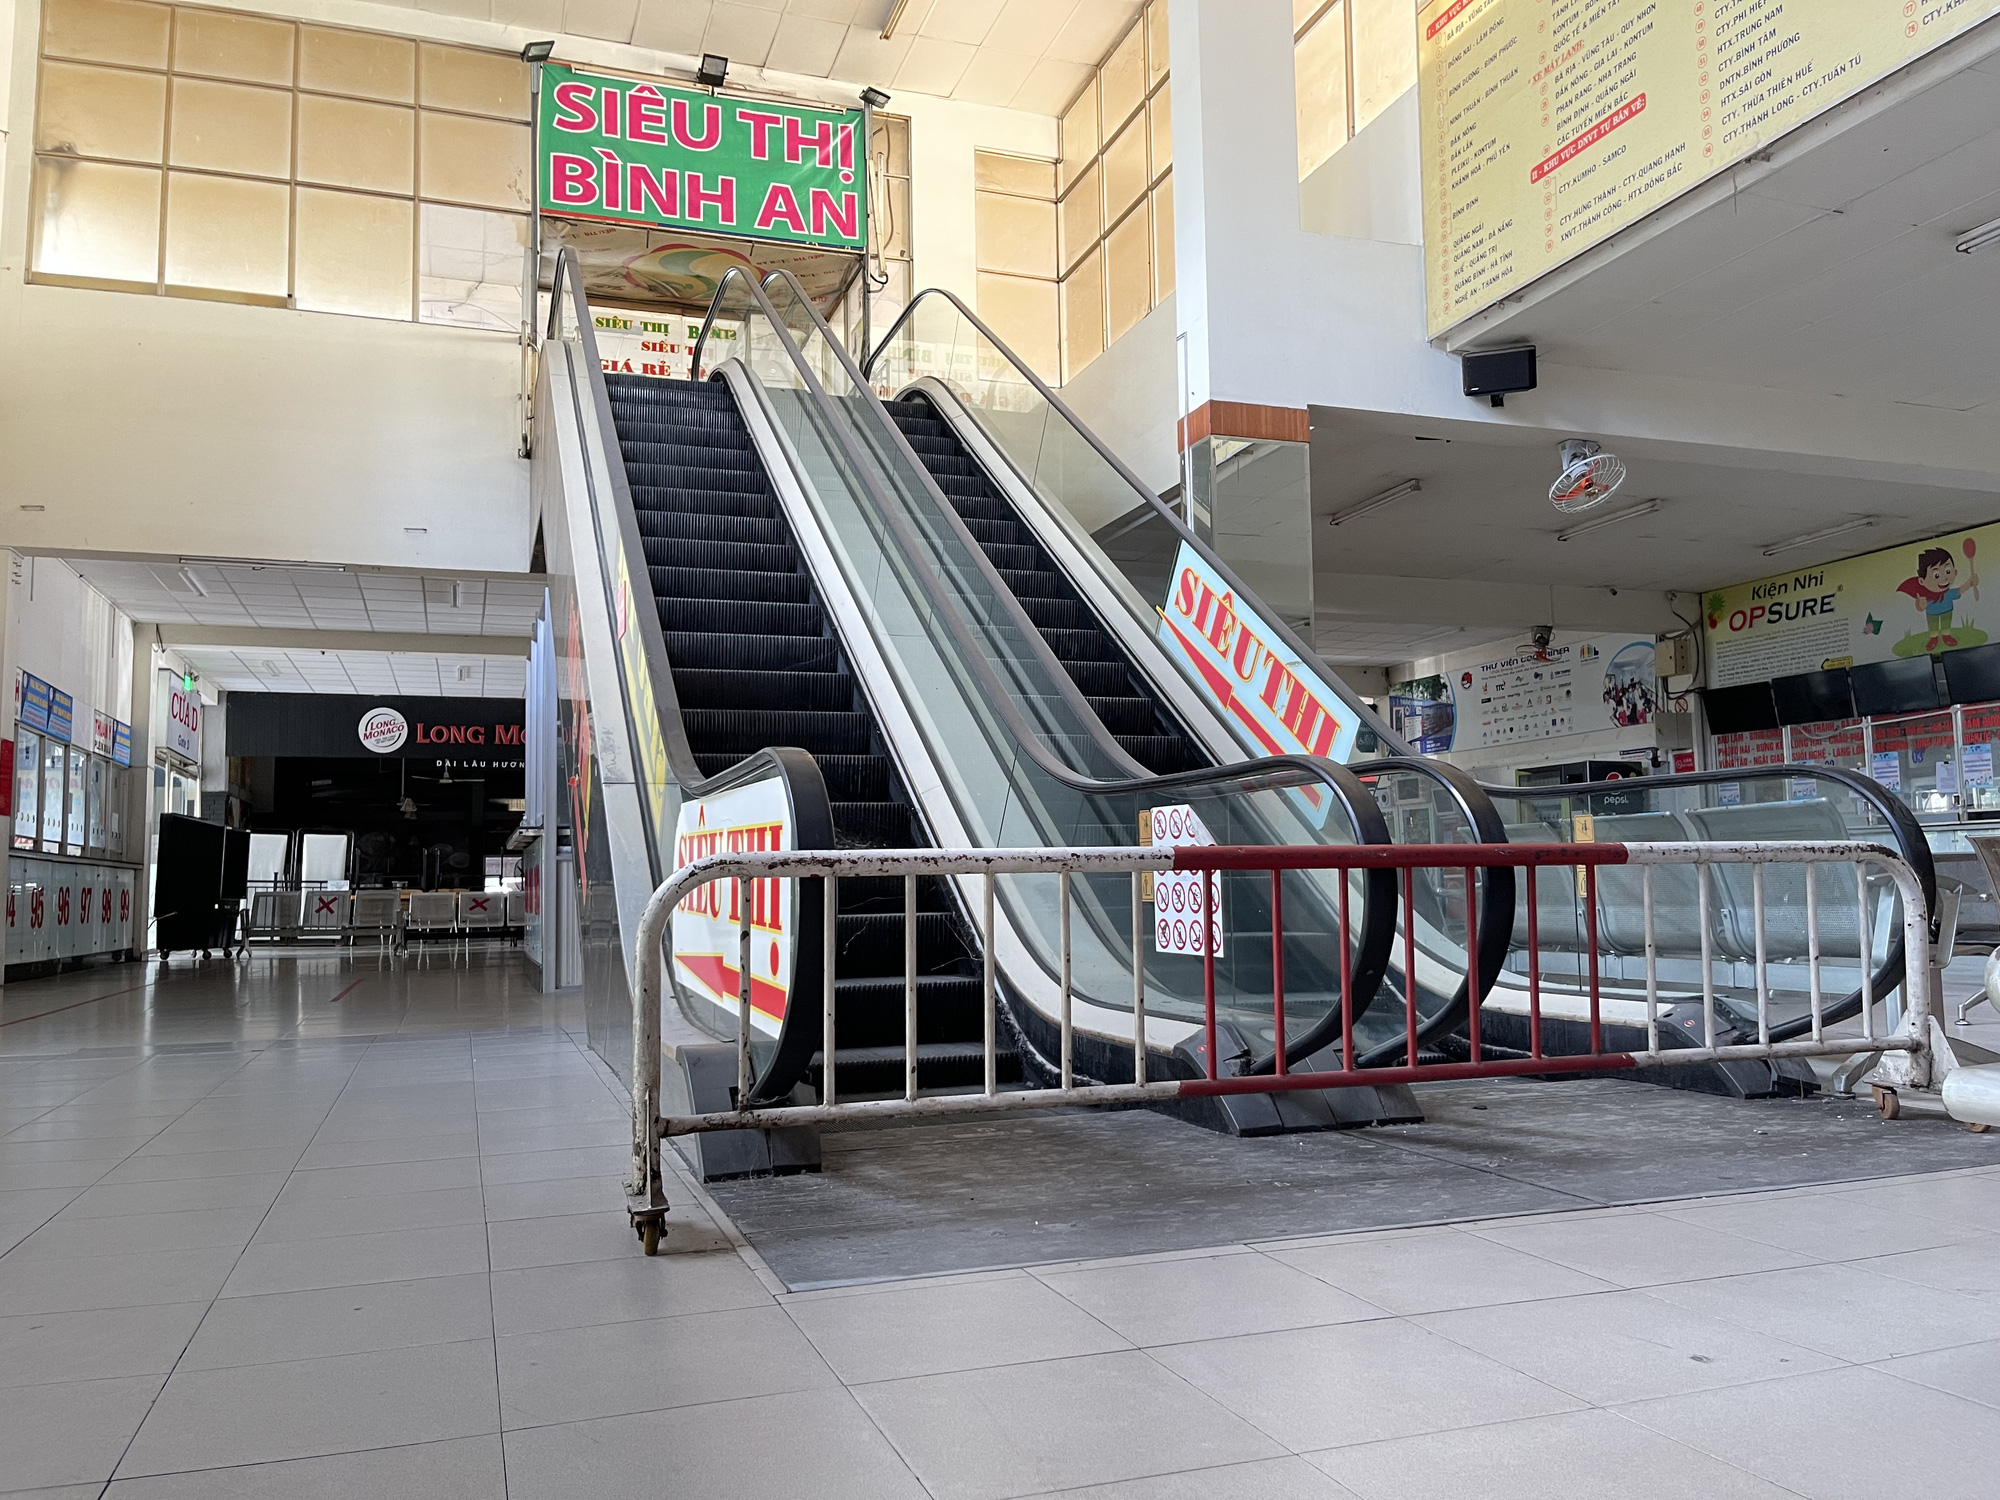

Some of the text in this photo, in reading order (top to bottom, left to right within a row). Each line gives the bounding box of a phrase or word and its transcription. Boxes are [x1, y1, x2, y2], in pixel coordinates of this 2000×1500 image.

[1552, 10, 1579, 37] KONTUM
[1716, 8, 1747, 36] CTY.PHI
[1717, 18, 1762, 54] HTX.TRUNG
[1764, 4, 1784, 24] NAM
[1594, 58, 1605, 71] GIA
[1606, 48, 1618, 62] LAI
[1624, 22, 1654, 50] KONTUM
[1556, 51, 1637, 115] PHAN RANG NHA TRANG
[552, 82, 856, 185] SIÊU THỊ
[1722, 108, 1770, 144] CTY.THÀNH
[1771, 94, 1794, 115] LONG
[1543, 156, 1560, 173] KHU
[1558, 144, 1627, 194] CTY.KUMHO SAMCO
[1622, 156, 1663, 187] CTY.QUANG
[550, 146, 859, 239] BÌNH AN
[595, 315, 633, 330] SIÊU
[640, 320, 670, 337] THỊ
[641, 340, 680, 354] SIÊU
[641, 361, 671, 377] RẺ
[1751, 570, 1825, 601] Kiện Nhi
[1174, 566, 1266, 683] SIÊU
[1728, 592, 1836, 632] OPSURE
[191, 706, 198, 732] D
[363, 724, 405, 741] MONACO
[370, 718, 396, 731] LONG
[416, 722, 486, 746] LONG
[1912, 750, 1924, 764] 03
[1603, 795, 1630, 806] pepsi
[30, 886, 45, 929] 95
[57, 886, 70, 926] 96
[80, 887, 92, 925] 97
[101, 888, 112, 924] 98
[120, 888, 130, 922] 99
